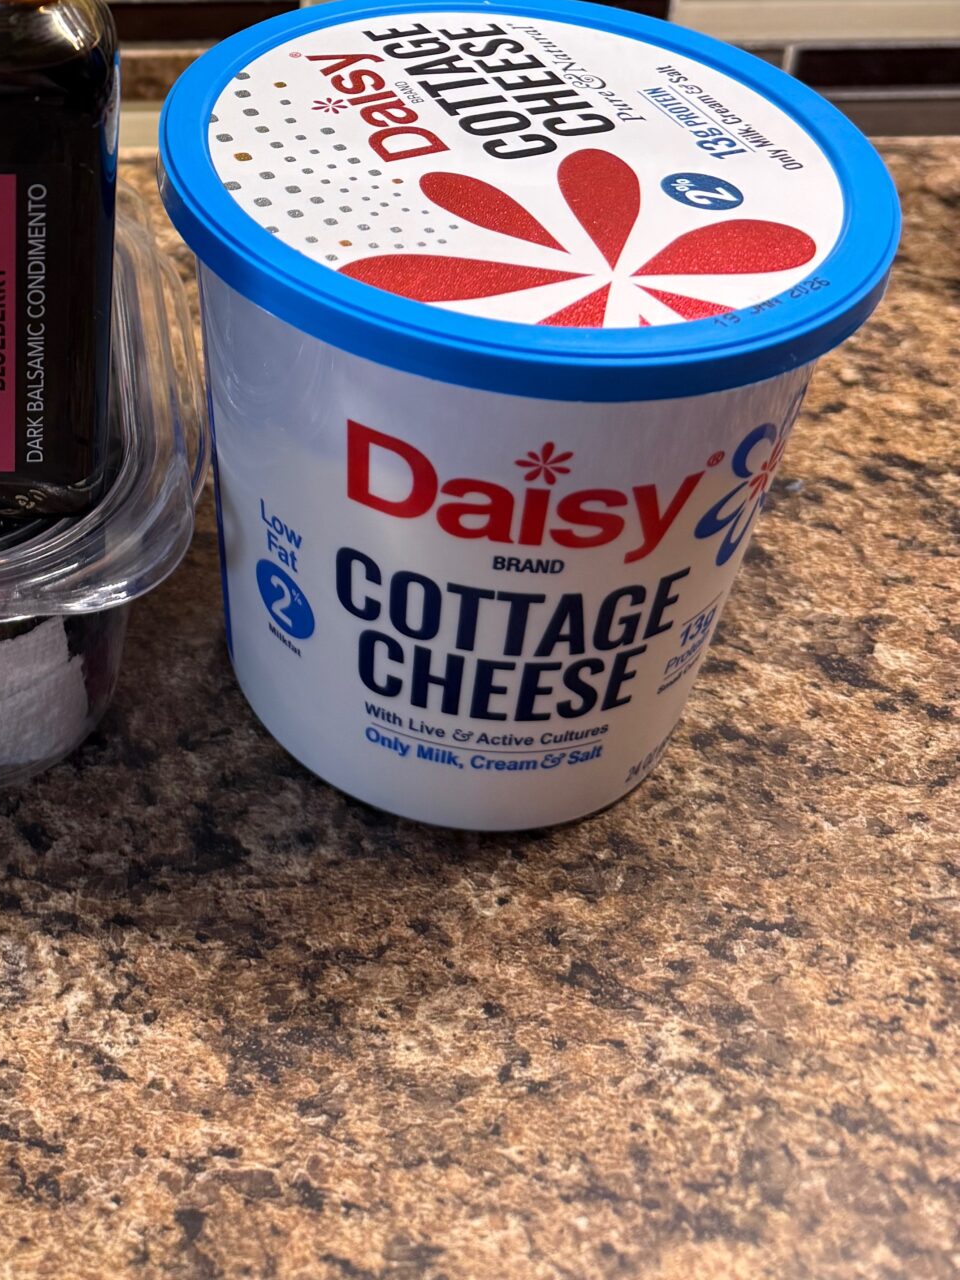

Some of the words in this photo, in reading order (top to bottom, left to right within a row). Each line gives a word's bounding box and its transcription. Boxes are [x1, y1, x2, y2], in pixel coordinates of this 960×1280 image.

[362, 23, 557, 159] COTTAGE
[394, 81, 424, 104] BRAND
[437, 23, 615, 137] CHEESE
[563, 74, 607, 90] &
[656, 65, 688, 84] Salt
[679, 84, 703, 95] &
[305, 53, 451, 162] Daisy
[598, 91, 647, 122] Pure
[643, 87, 707, 128] PROTEIN
[698, 95, 742, 125] Cream
[690, 127, 747, 160] 13g
[738, 124, 774, 148] Milk,
[767, 149, 804, 170] Only
[671, 178, 739, 205] 2%
[27, 183, 48, 318] CONDIMENTO
[27, 323, 44, 411] BALSAMIC
[26, 417, 43, 463] DARK
[347, 419, 705, 564] Daisy
[260, 498, 302, 550] Low
[267, 529, 298, 573] Fat
[492, 555, 565, 575] BRAND
[336, 547, 691, 657] COTTAGE
[268, 622, 302, 658] Milkfat
[358, 629, 648, 721] CHEESE
[364, 700, 403, 727] With
[408, 718, 445, 738] Live
[452, 729, 475, 742] &
[476, 732, 534, 747] Active
[539, 723, 609, 746] Cultures
[365, 726, 410, 757] Only
[416, 744, 464, 770] Milk,
[470, 754, 538, 771] Cream
[541, 752, 567, 769] &
[566, 745, 604, 766] Salt
